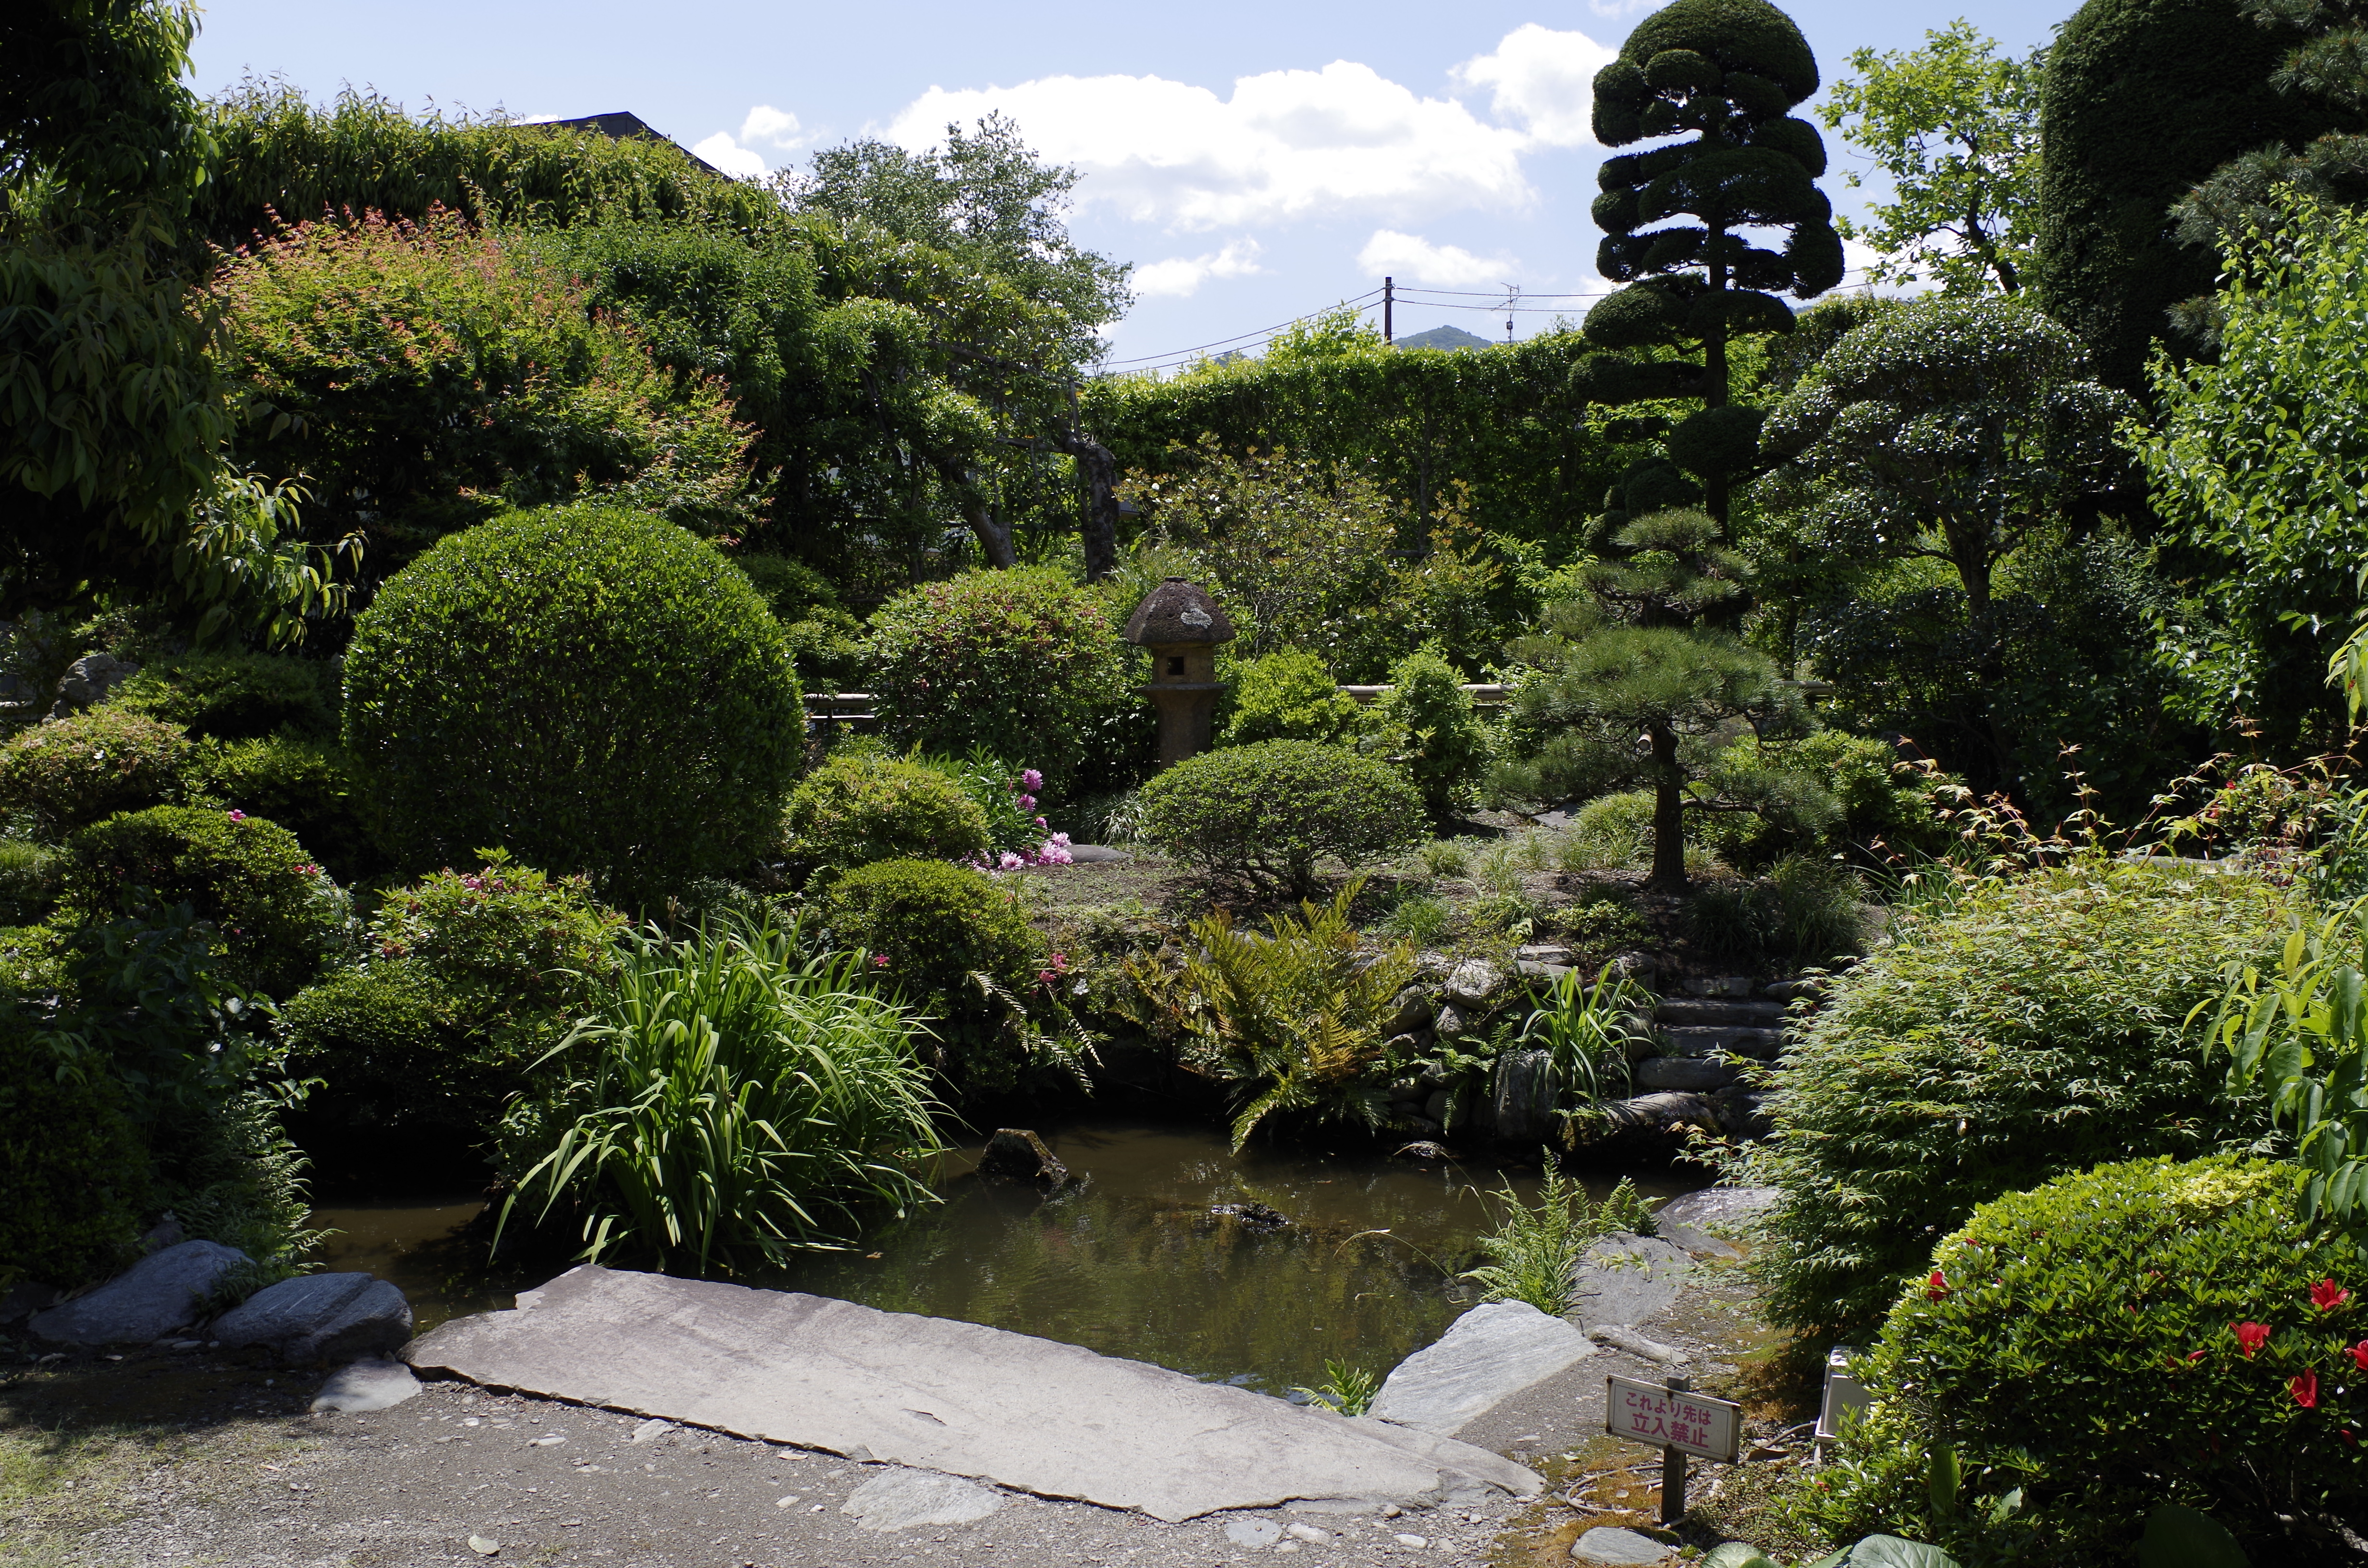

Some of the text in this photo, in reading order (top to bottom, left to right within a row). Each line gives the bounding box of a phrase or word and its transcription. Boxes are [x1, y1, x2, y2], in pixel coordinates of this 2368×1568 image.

[1626, 1392, 1711, 1425] これより先は
[1631, 1413, 1709, 1448] 立入禁止
